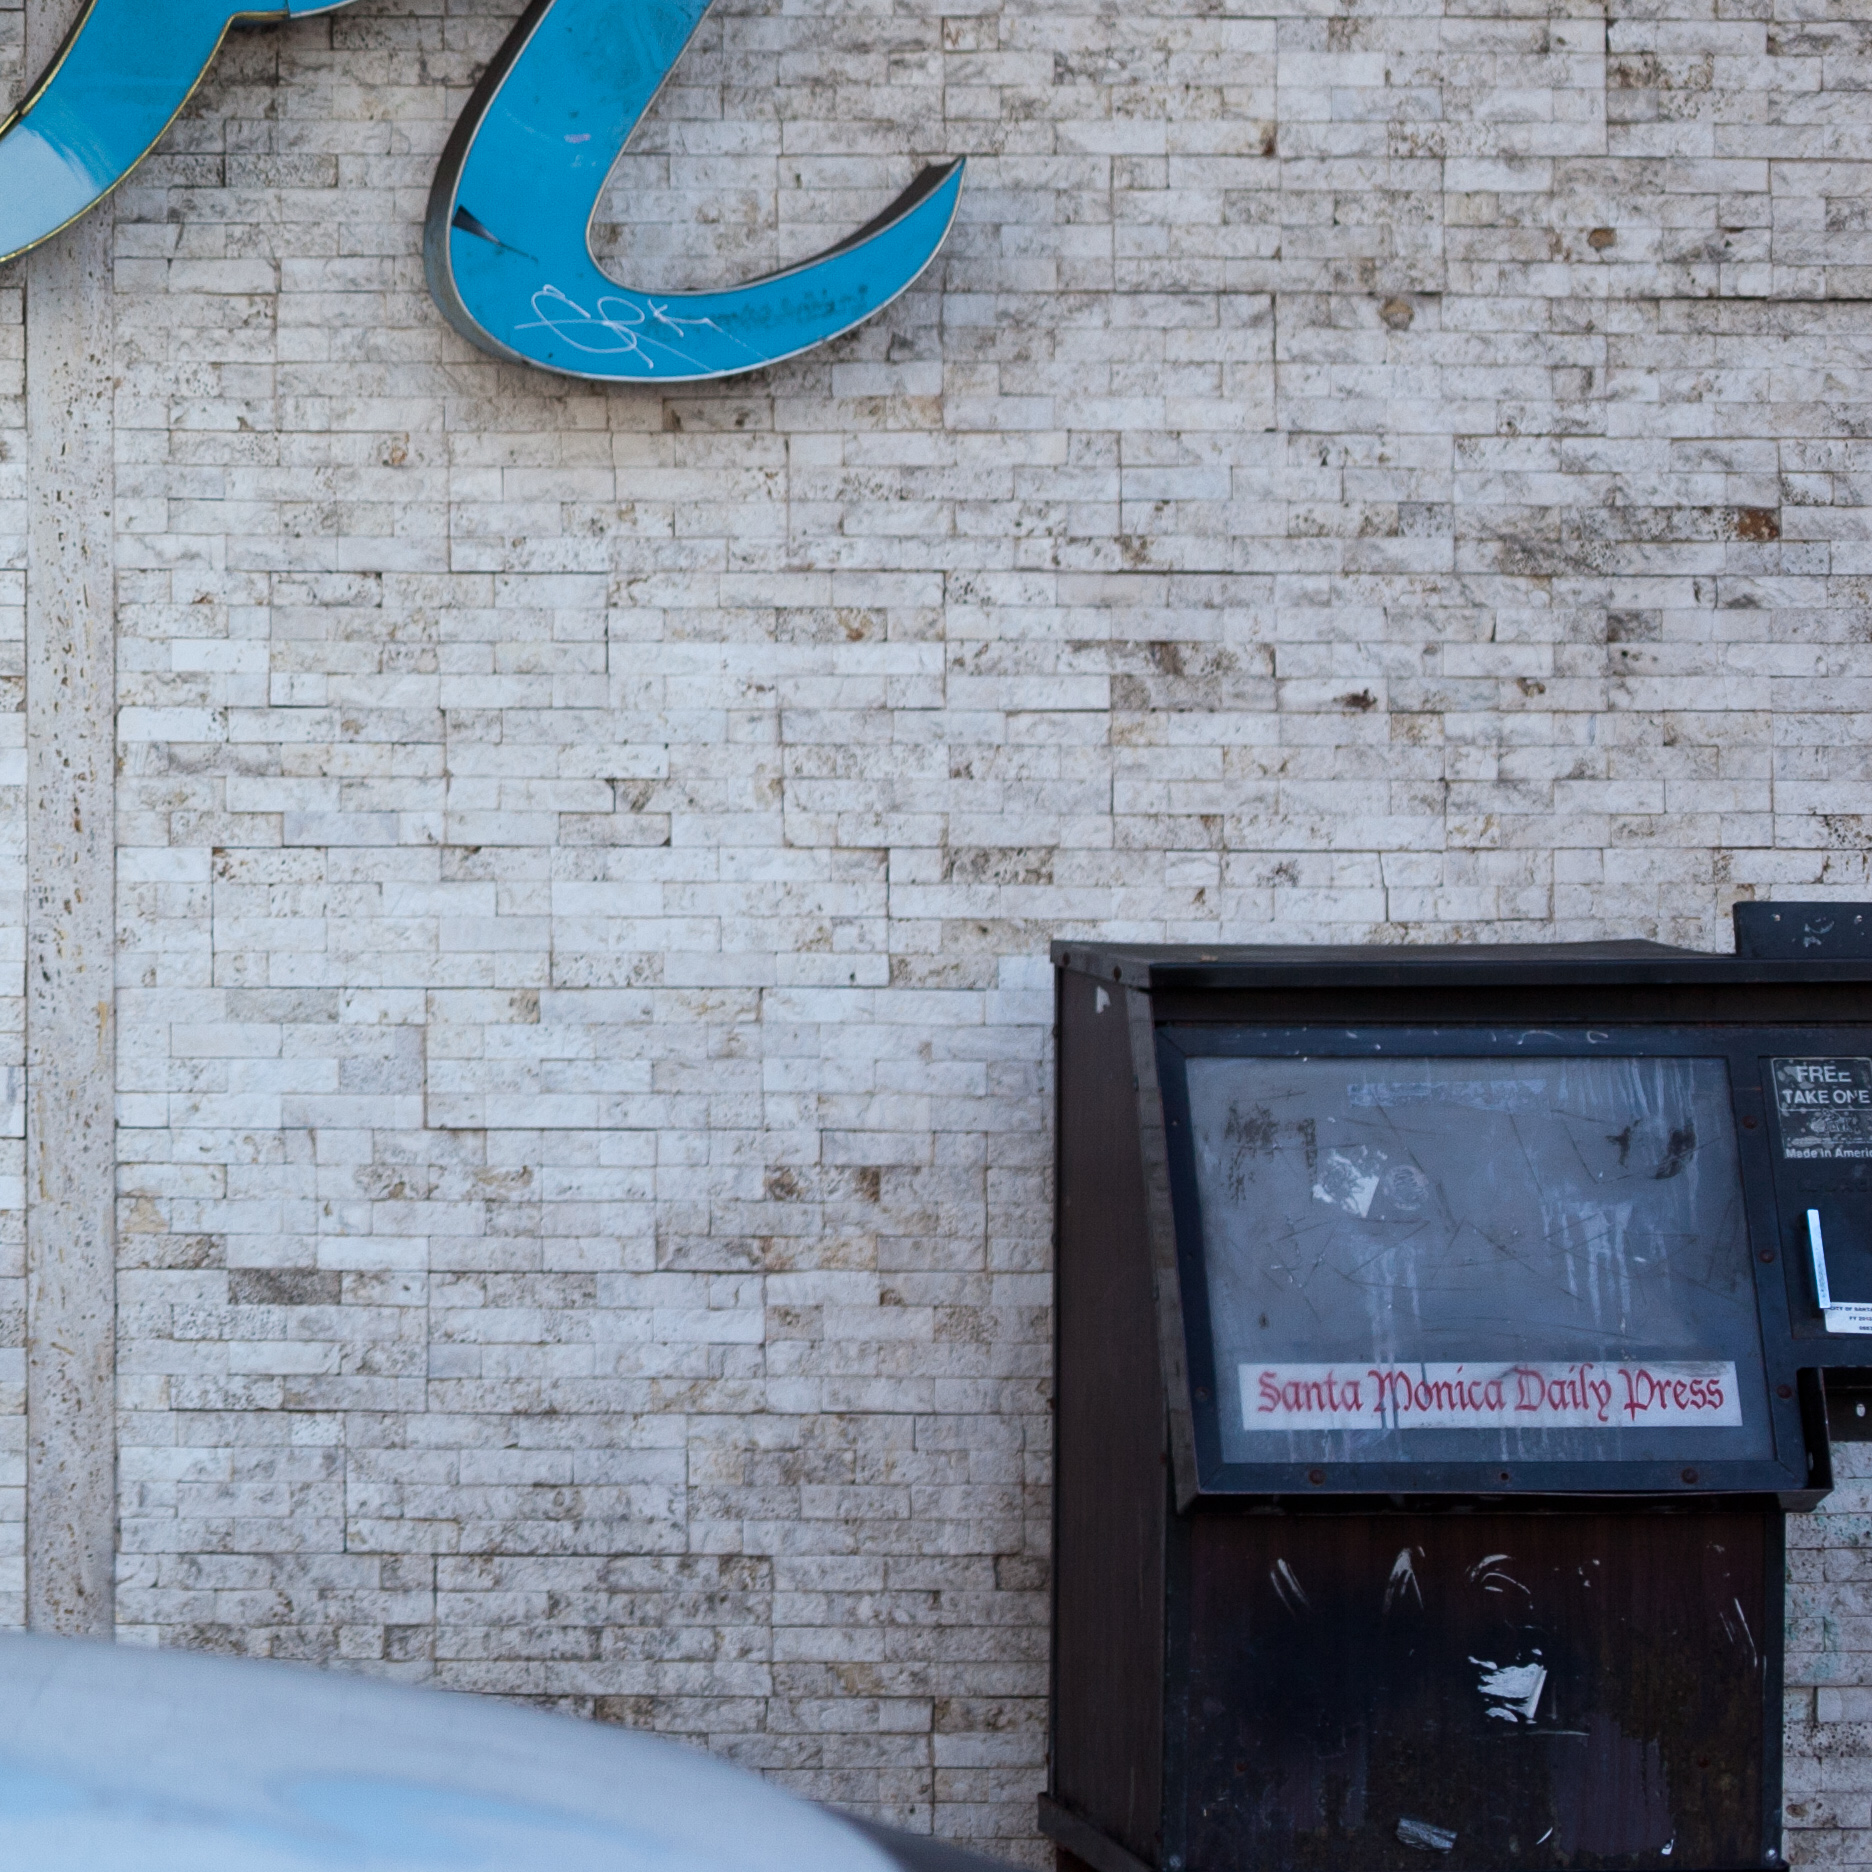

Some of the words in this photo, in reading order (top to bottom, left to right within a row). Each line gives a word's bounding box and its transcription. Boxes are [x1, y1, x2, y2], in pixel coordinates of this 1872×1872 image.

[1795, 1065, 1853, 1083] FREE
[1781, 1089, 1831, 1105] TAKE
[1832, 1089, 1872, 1105] ONE
[1785, 1148, 1817, 1159] Made
[1257, 1368, 1364, 1414] Santa
[1367, 1365, 1506, 1414] Monica
[1513, 1362, 1613, 1422] Daily
[1617, 1367, 1725, 1421] Press
